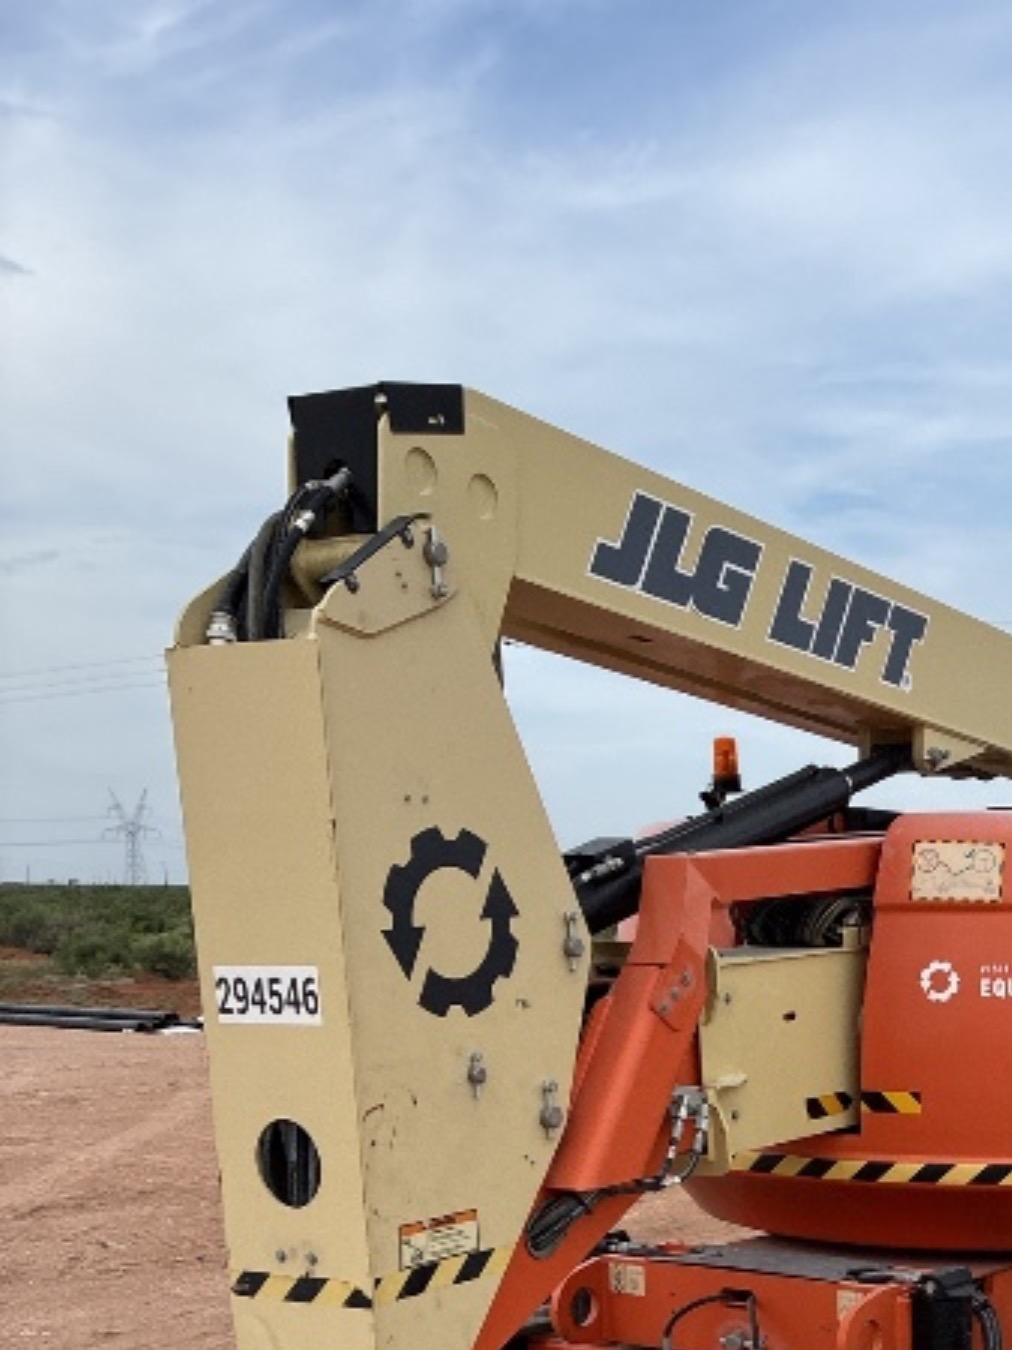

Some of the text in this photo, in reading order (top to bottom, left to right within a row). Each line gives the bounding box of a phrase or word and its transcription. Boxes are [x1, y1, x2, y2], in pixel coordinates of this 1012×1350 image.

[586, 488, 930, 691] JLG LIFT
[215, 977, 319, 1015] 294546
